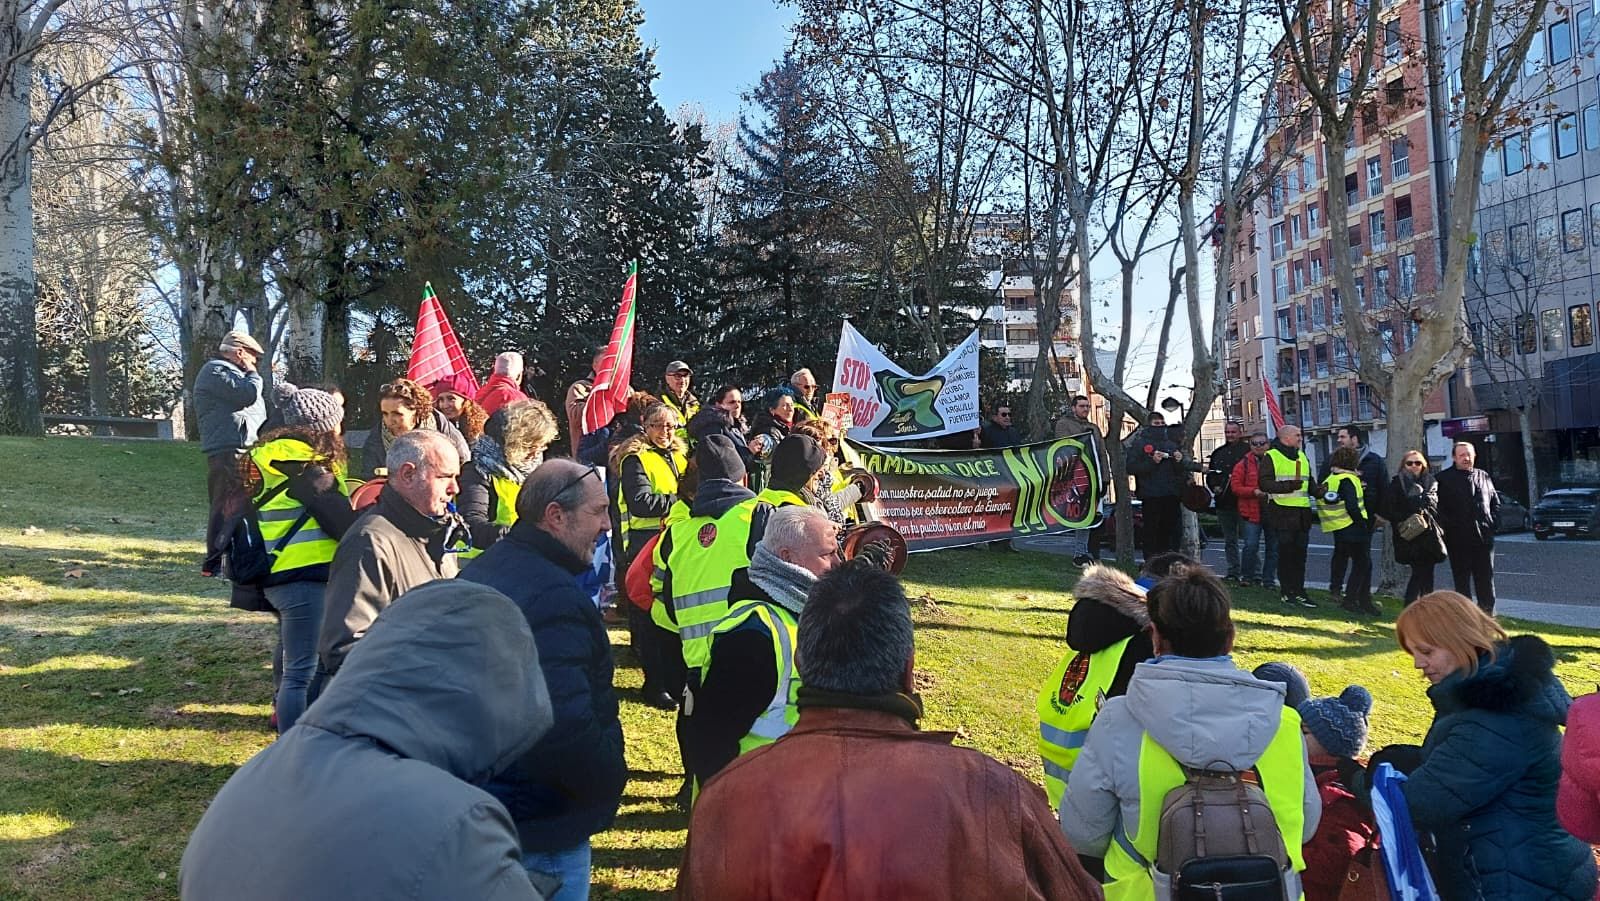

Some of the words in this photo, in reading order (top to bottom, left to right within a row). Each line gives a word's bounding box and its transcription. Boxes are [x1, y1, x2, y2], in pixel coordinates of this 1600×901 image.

[841, 357, 871, 391] STOP
[944, 384, 965, 396] CUBO
[955, 459, 1000, 478] DICE
[890, 485, 925, 500] nuestra
[924, 485, 952, 500] salud
[952, 489, 964, 498] no
[964, 488, 975, 499] se
[975, 484, 999, 501] juega.
[1002, 438, 1097, 533] NO
[911, 505, 923, 518] ser
[925, 501, 973, 517] estercolero
[974, 500, 985, 513] de
[985, 499, 1012, 515] Europa.
[900, 525, 909, 535] en
[911, 521, 920, 534] tu
[920, 519, 944, 537] pueblo
[944, 518, 953, 532] ni
[952, 522, 962, 532] en
[963, 518, 972, 530] el
